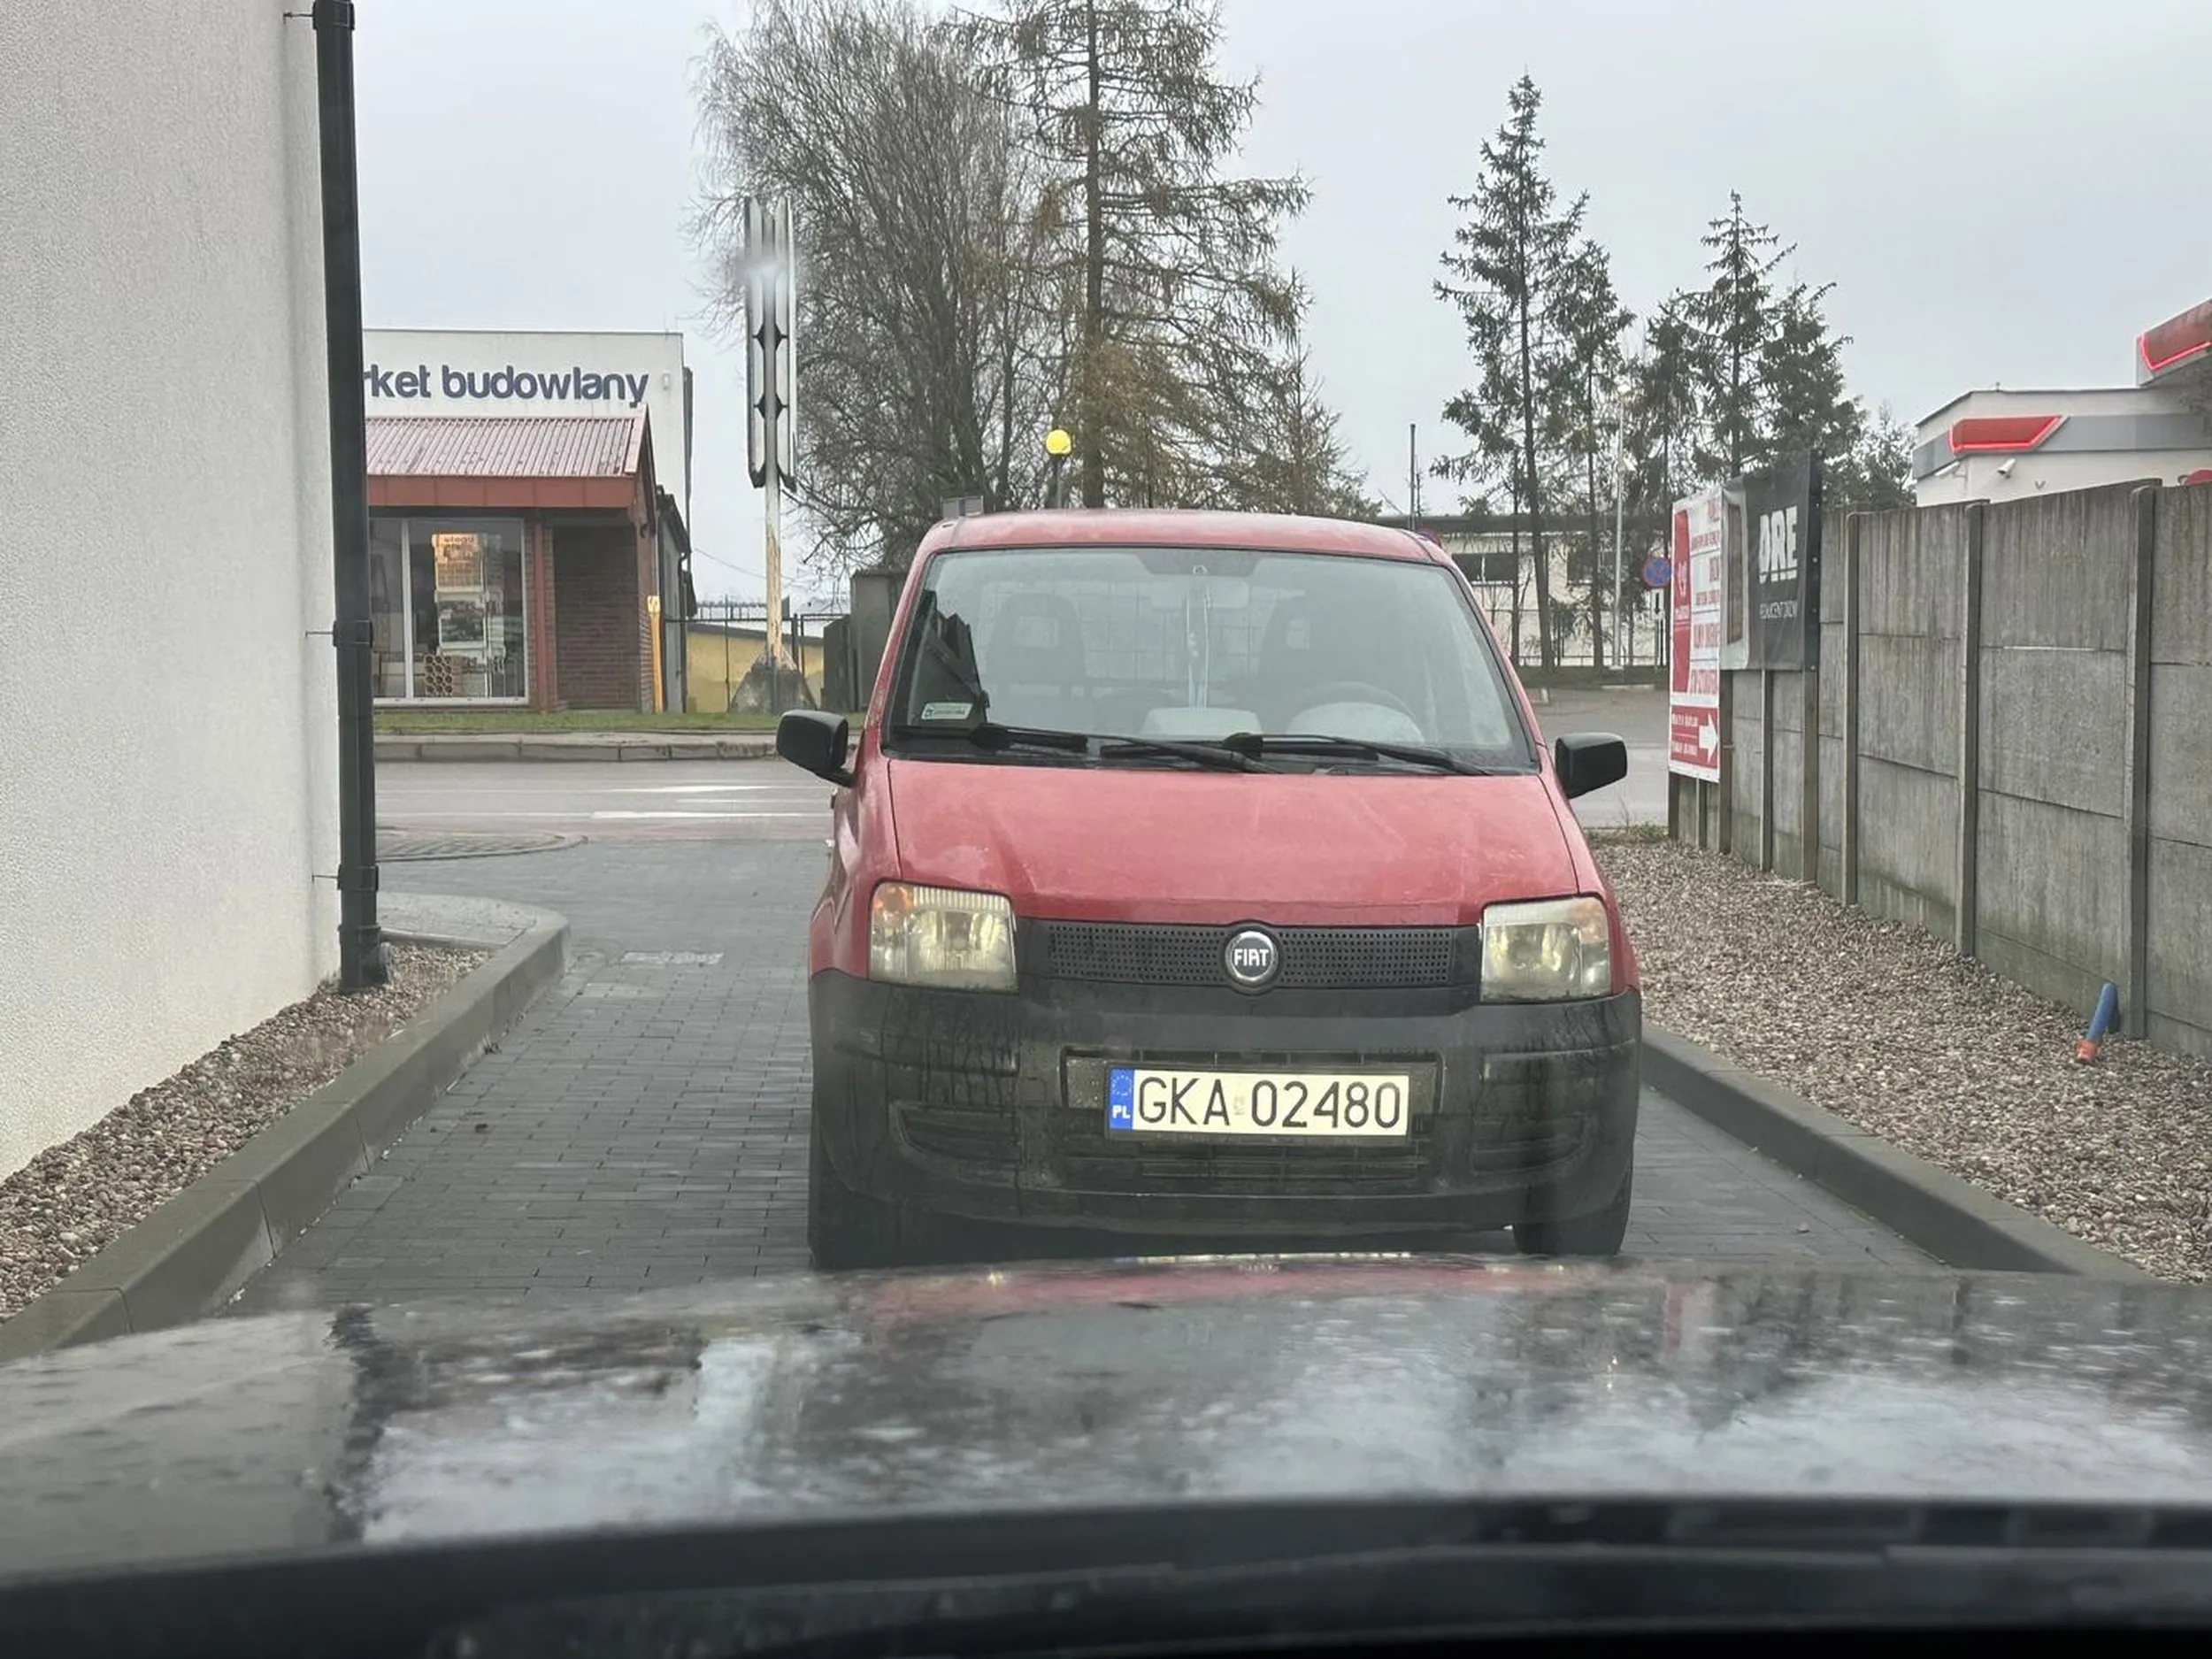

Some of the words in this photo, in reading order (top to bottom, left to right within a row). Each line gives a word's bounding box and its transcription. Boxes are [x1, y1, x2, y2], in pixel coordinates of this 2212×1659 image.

[442, 365, 649, 408] budowlany
[1233, 948, 1270, 967] FIAT
[1112, 1105, 1131, 1120] PL
[1139, 1077, 1231, 1126] GKA
[1251, 1079, 1401, 1129] 02480
